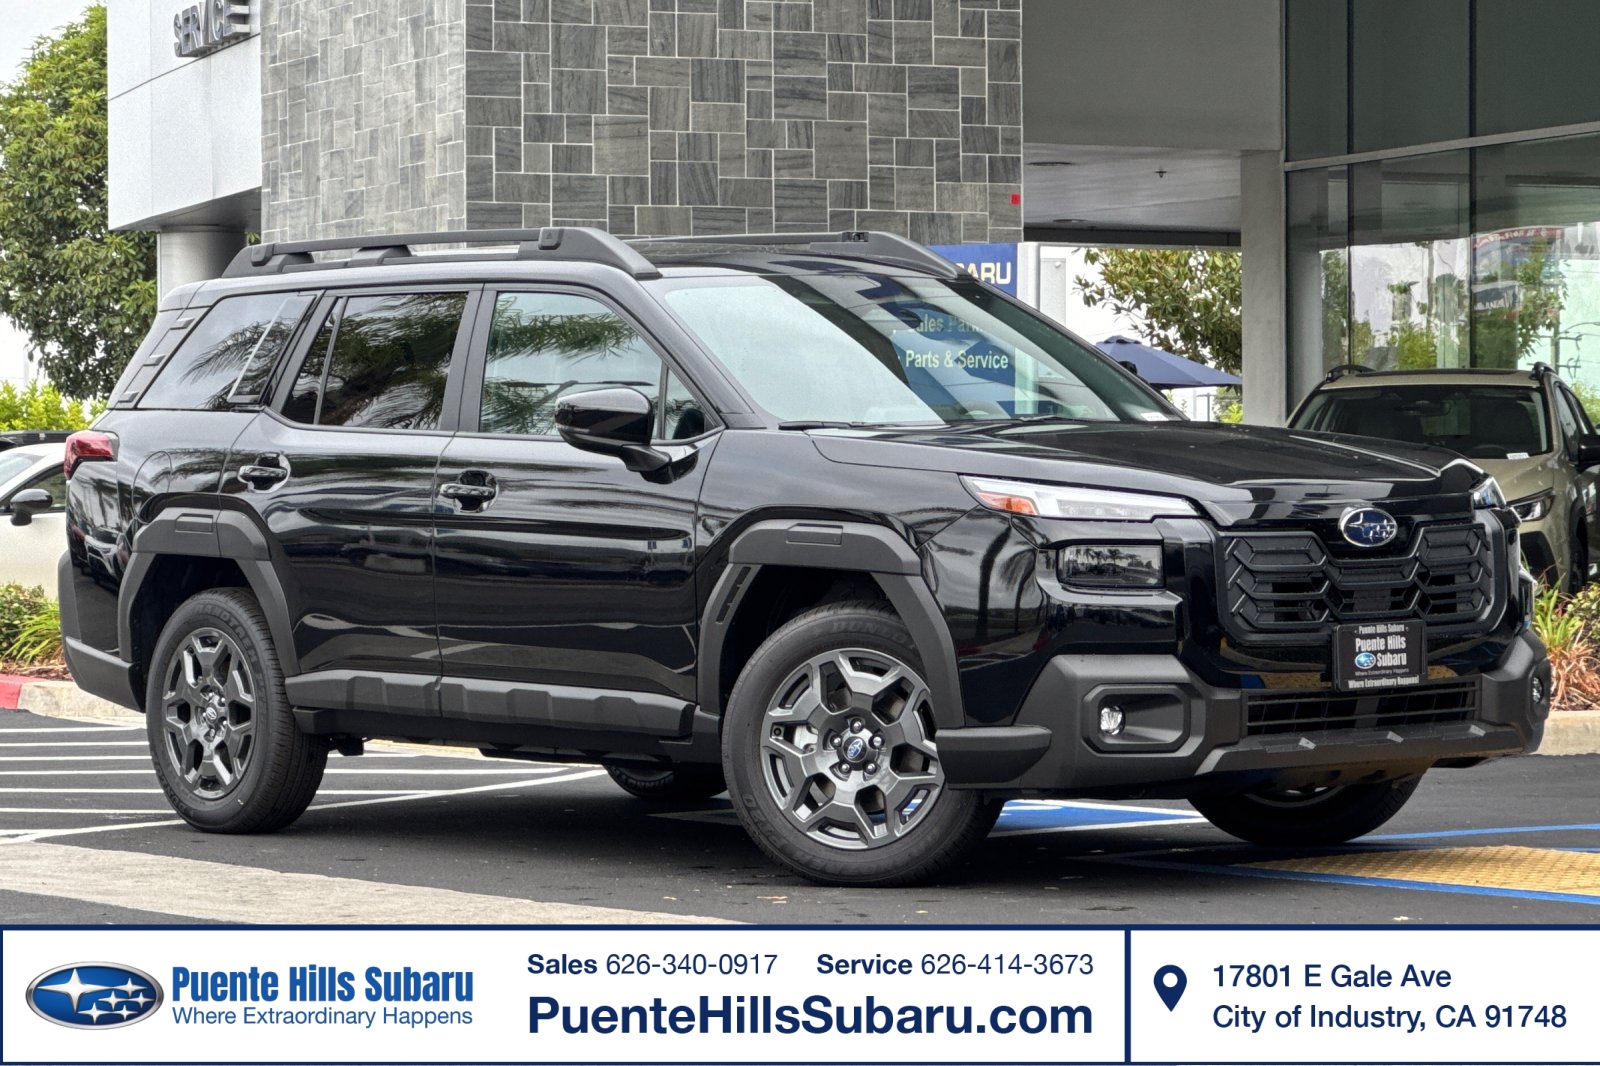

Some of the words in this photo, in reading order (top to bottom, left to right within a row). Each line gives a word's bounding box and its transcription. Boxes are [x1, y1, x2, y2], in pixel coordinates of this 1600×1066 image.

[173, 0, 250, 57] SERVICE
[905, 350, 939, 368] Parts
[943, 350, 953, 367] &
[956, 350, 1009, 369] Service
[1355, 636, 1385, 652] Puente
[1387, 634, 1406, 650] Hills
[1376, 652, 1407, 667] Subaru
